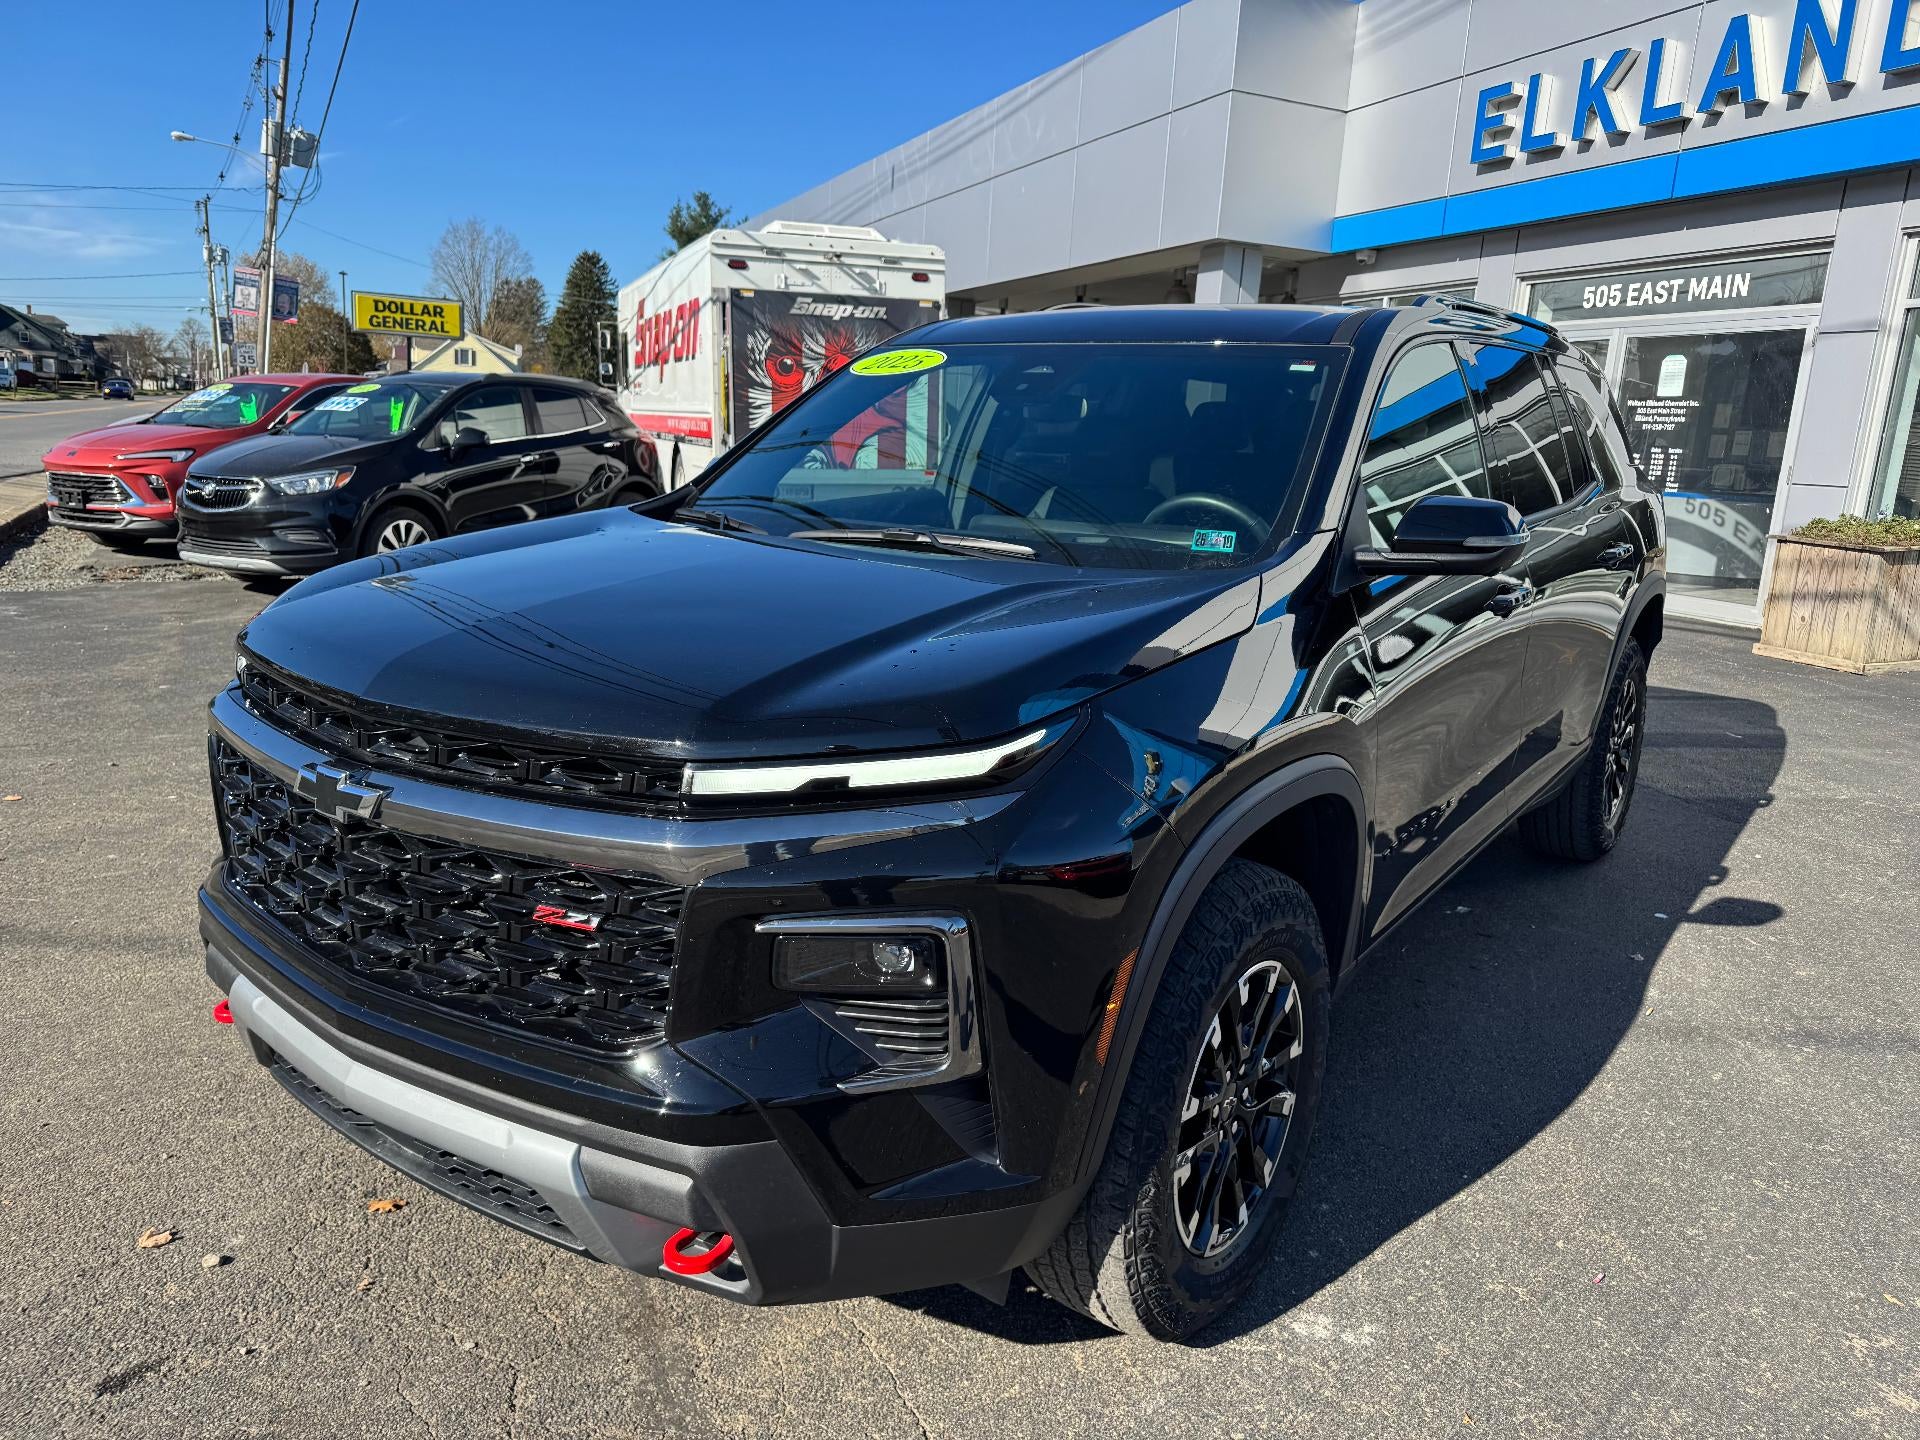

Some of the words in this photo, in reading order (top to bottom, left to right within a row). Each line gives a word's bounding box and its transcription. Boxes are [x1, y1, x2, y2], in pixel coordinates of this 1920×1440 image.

[1582, 284, 1623, 309] 505
[1626, 278, 1684, 307] EAST
[1688, 272, 1751, 302] MAIN
[373, 299, 445, 319] DOLLAR
[368, 314, 450, 334] GENERAL
[635, 297, 700, 384] Snap-on
[239, 354, 256, 365] 35
[861, 354, 935, 370] 2025
[1684, 496, 1726, 528] 505
